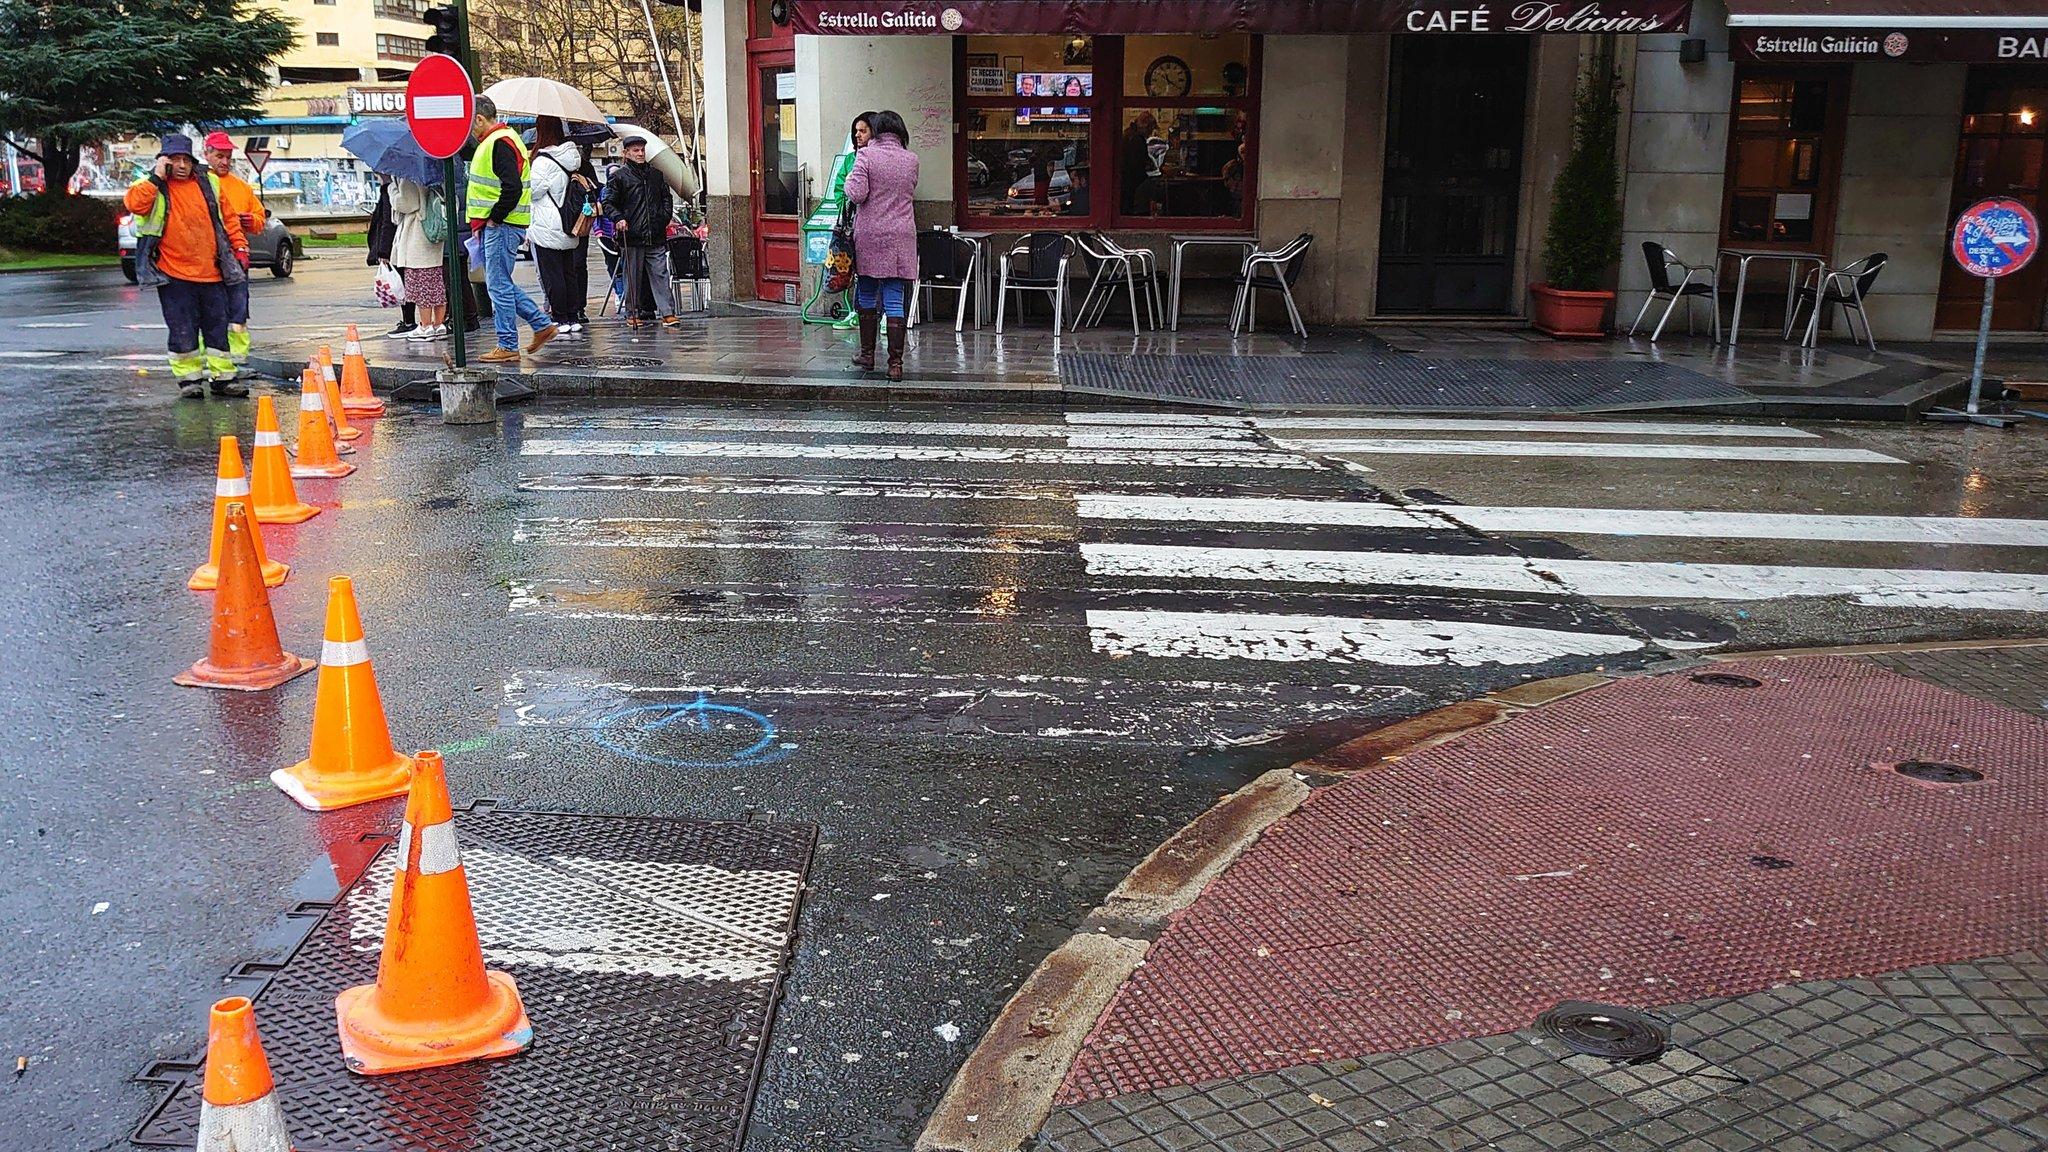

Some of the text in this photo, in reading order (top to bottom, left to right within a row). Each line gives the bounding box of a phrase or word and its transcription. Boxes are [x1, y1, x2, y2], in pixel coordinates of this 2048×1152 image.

[818, 11, 937, 28] Estrella Galicia
[1406, 1, 1663, 32] CAFÉ Delicias
[1755, 35, 1879, 54] Estrella Galicia
[352, 92, 406, 111] BINGO
